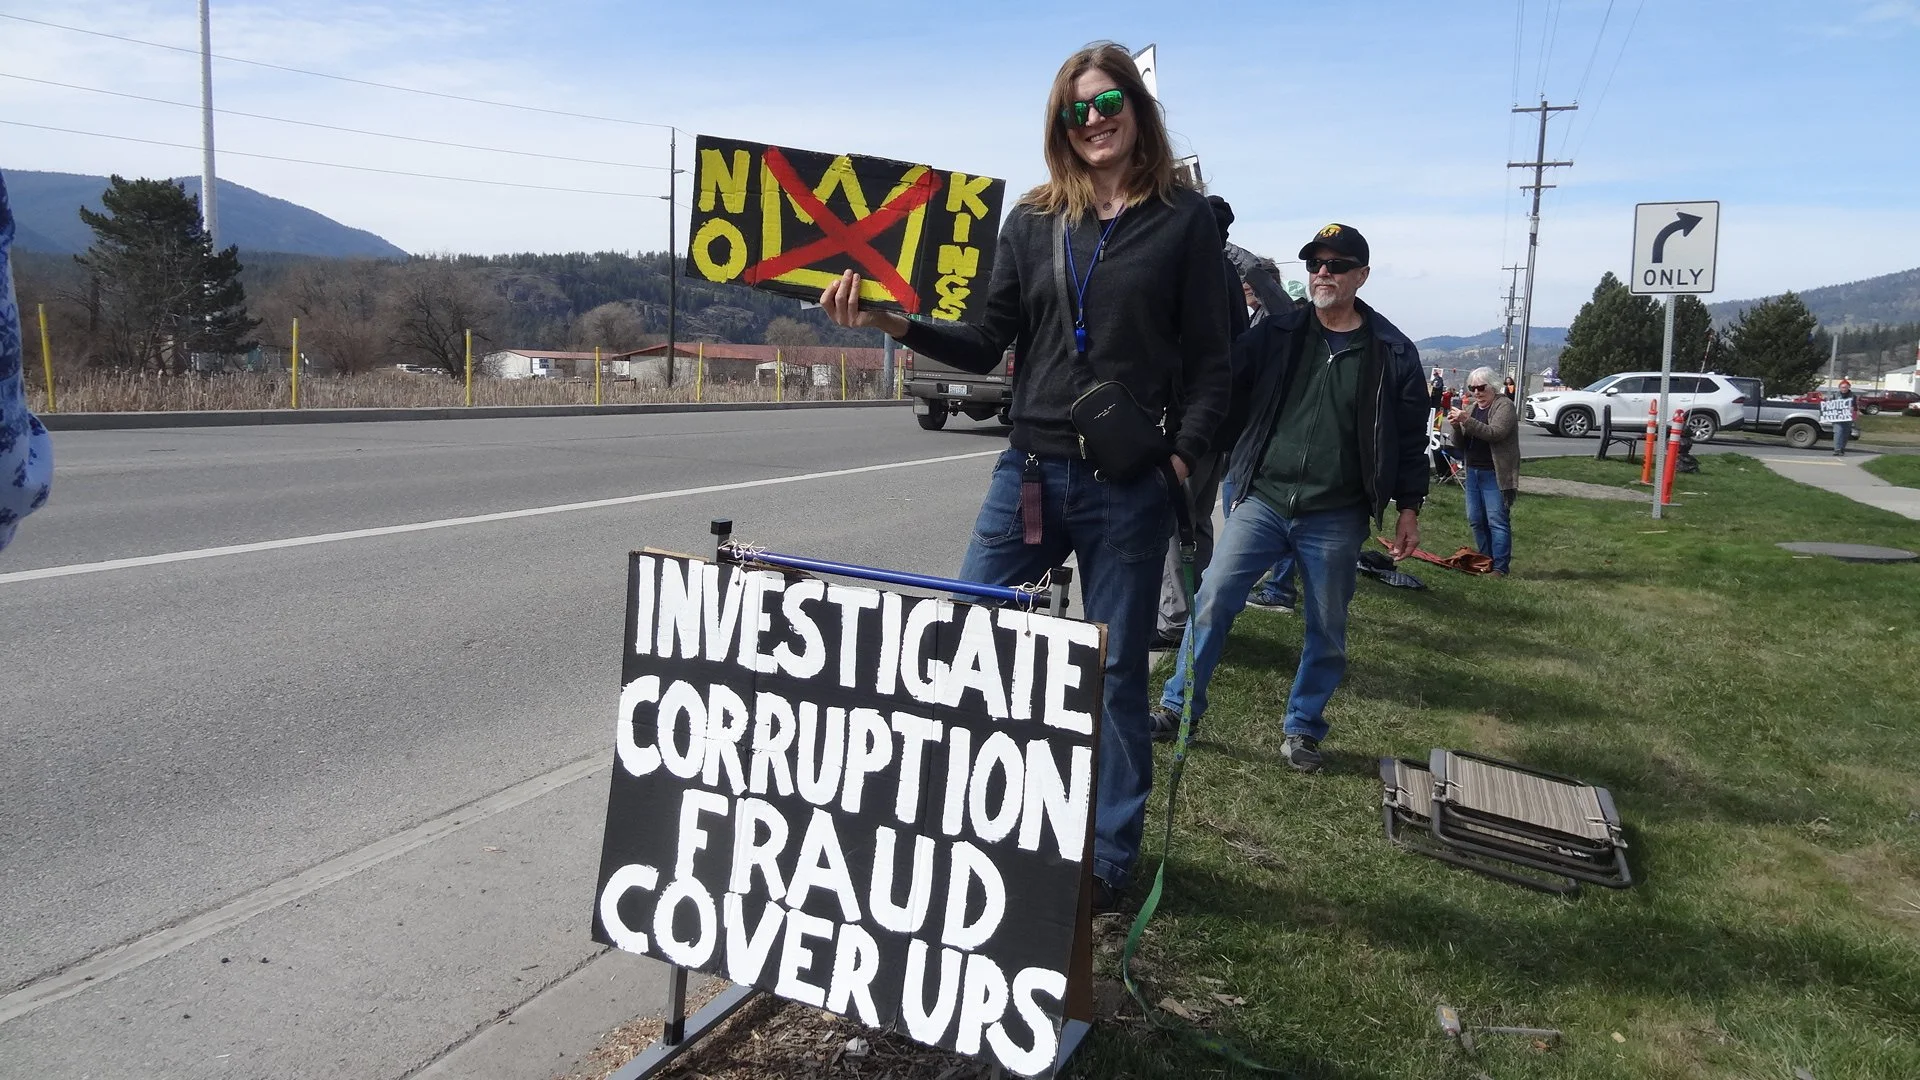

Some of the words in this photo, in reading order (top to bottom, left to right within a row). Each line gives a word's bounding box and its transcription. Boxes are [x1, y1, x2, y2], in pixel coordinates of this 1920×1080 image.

[692, 148, 751, 283] NO
[931, 172, 993, 321] KINGS
[1643, 268, 1704, 286] ONLY
[1820, 398, 1853, 412] PROTECT
[635, 555, 1101, 735] INVESTIGATE
[615, 674, 1092, 861] CORRUPTION
[675, 788, 1007, 951] FRAUD
[600, 864, 880, 1028] COVER
[902, 938, 1068, 1076] UPS
